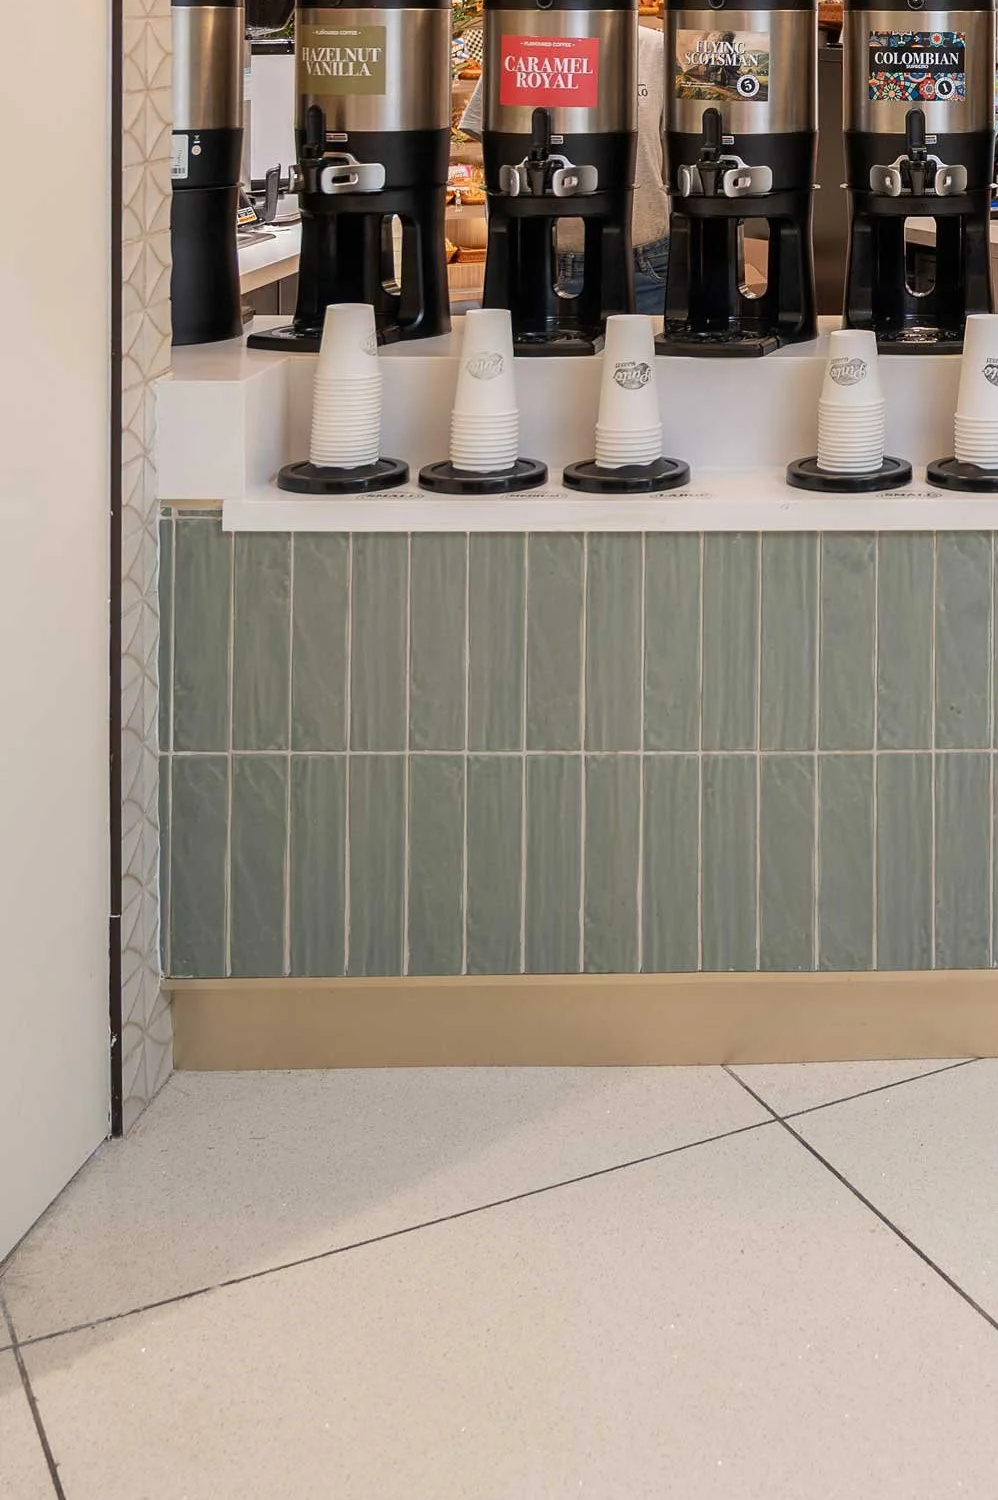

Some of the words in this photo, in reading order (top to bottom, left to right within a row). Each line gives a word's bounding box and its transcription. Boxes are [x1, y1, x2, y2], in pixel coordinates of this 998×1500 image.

[302, 46, 382, 62] HAZELNUT
[695, 40, 746, 55] FLYING
[504, 55, 594, 74] CARAMEL
[685, 51, 760, 67] SCOTSMAN
[874, 51, 960, 66] COLOMBIAN
[306, 61, 372, 77] VANILLA
[515, 71, 579, 89] ROYAL
[744, 80, 753, 92] 5
[941, 82, 950, 93] 1
[613, 367, 651, 385] Pinto
[830, 363, 867, 380] Pinto
